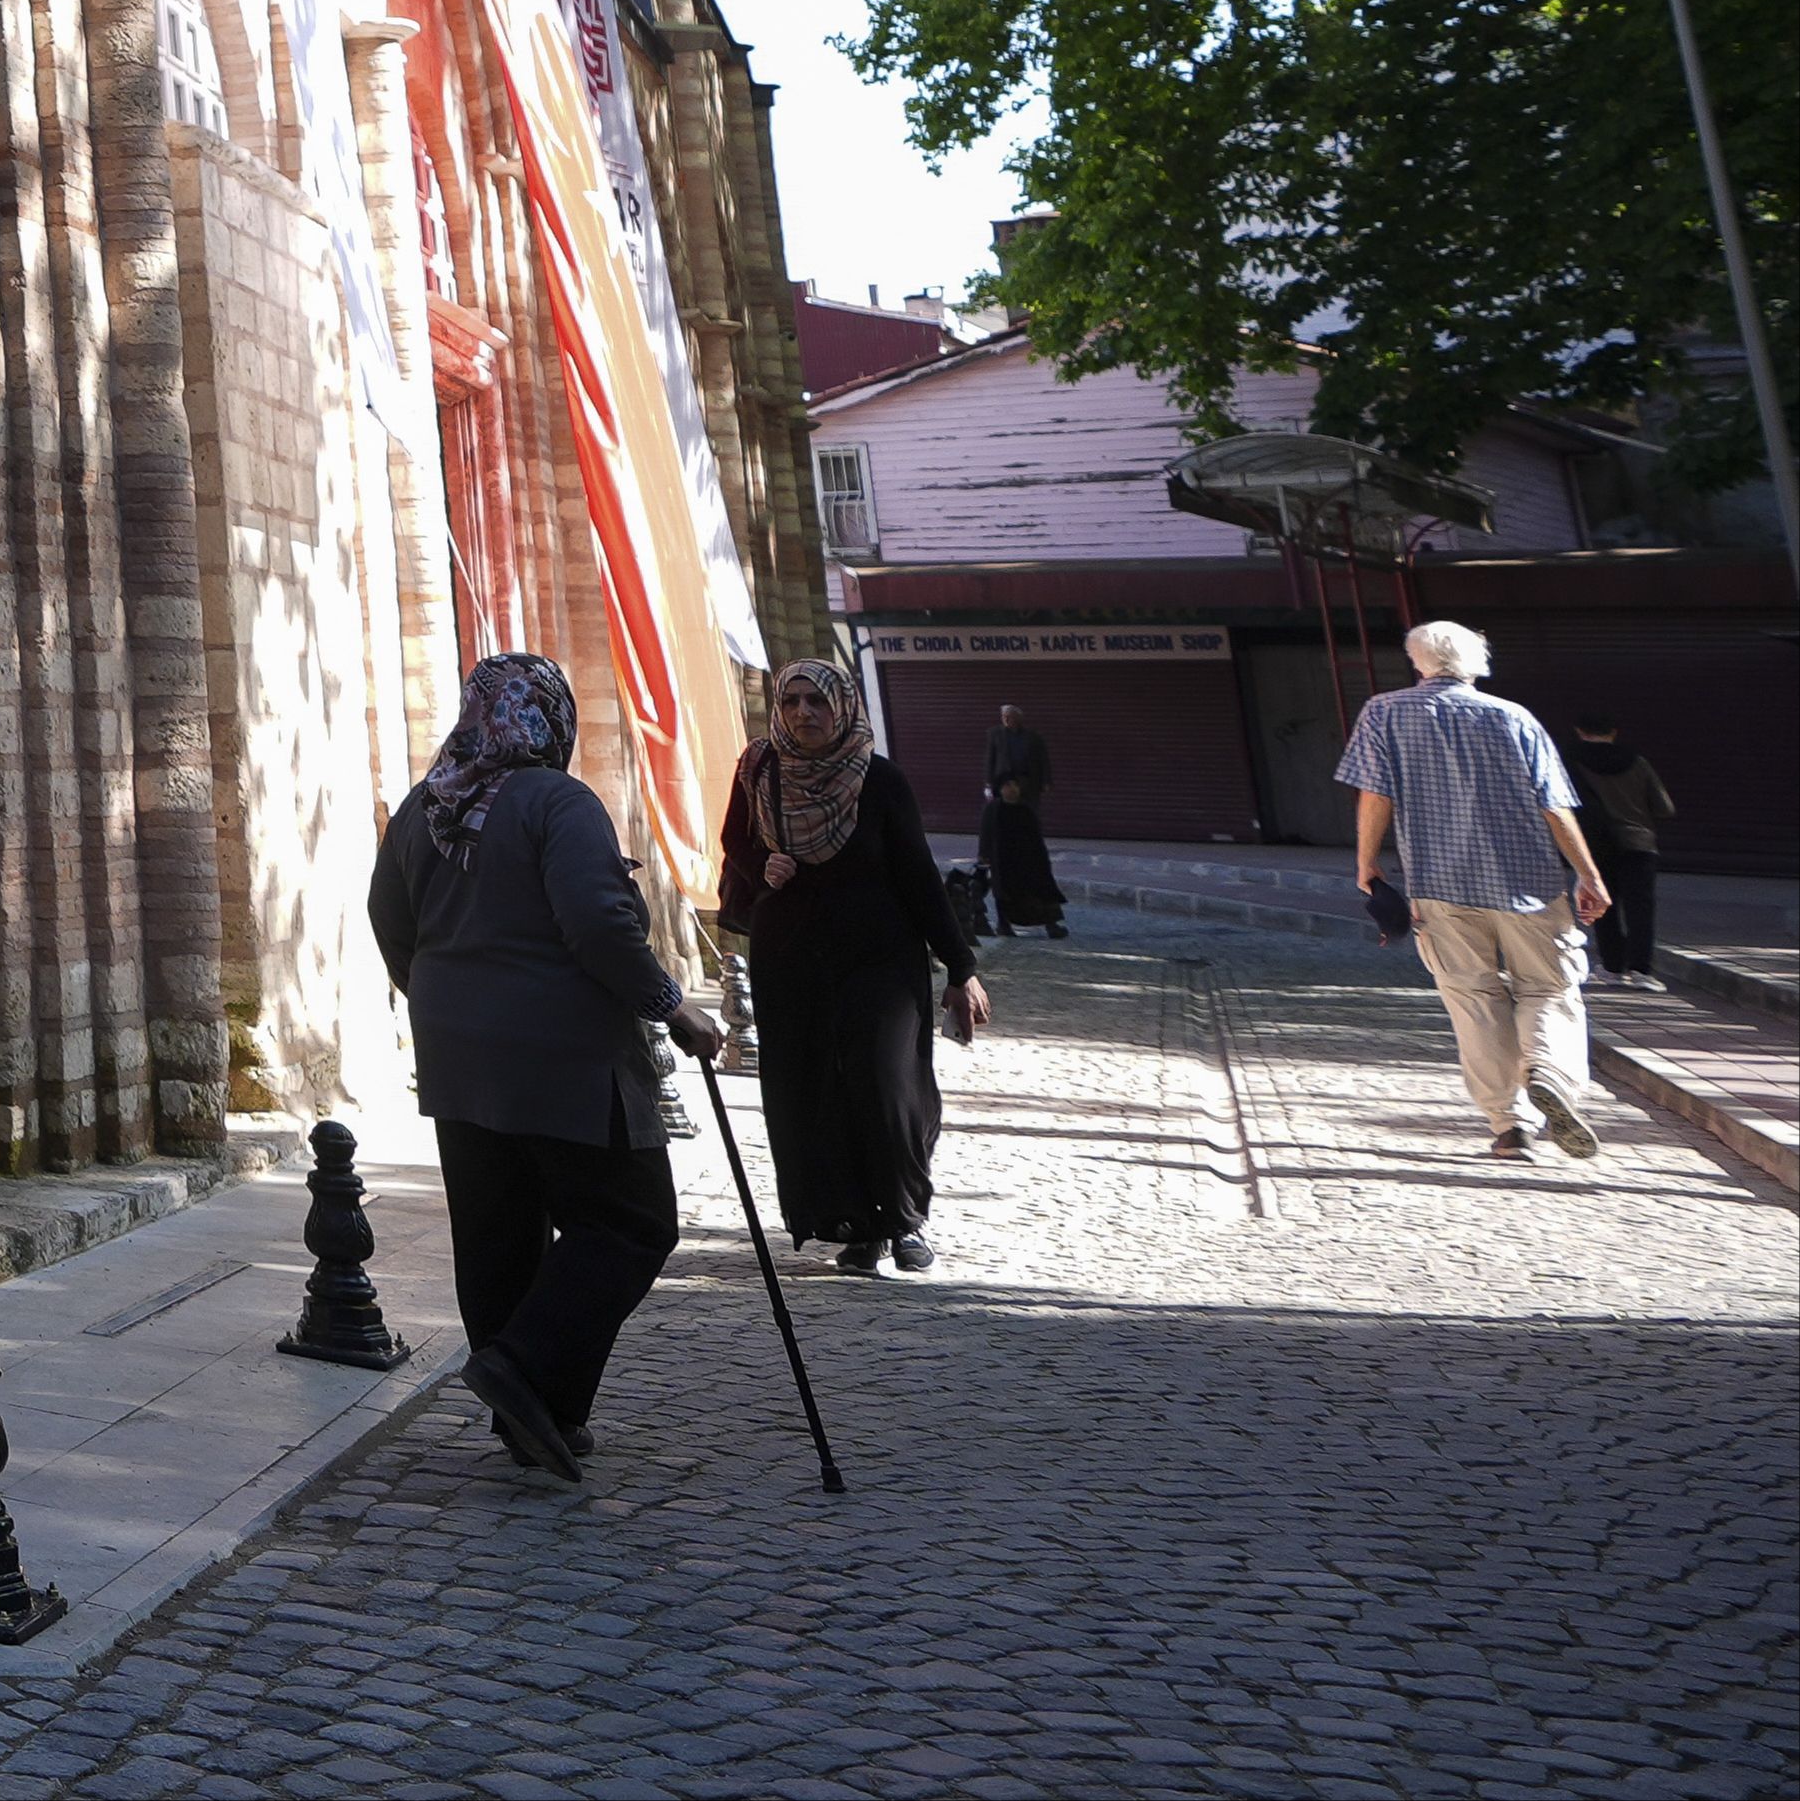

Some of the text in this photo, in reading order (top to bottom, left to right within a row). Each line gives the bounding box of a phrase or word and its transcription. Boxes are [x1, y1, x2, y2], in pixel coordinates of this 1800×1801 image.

[878, 636, 906, 652] THE
[913, 635, 962, 652] CHORA
[1104, 634, 1174, 651] MUSEUM
[1180, 634, 1222, 650] SHOP
